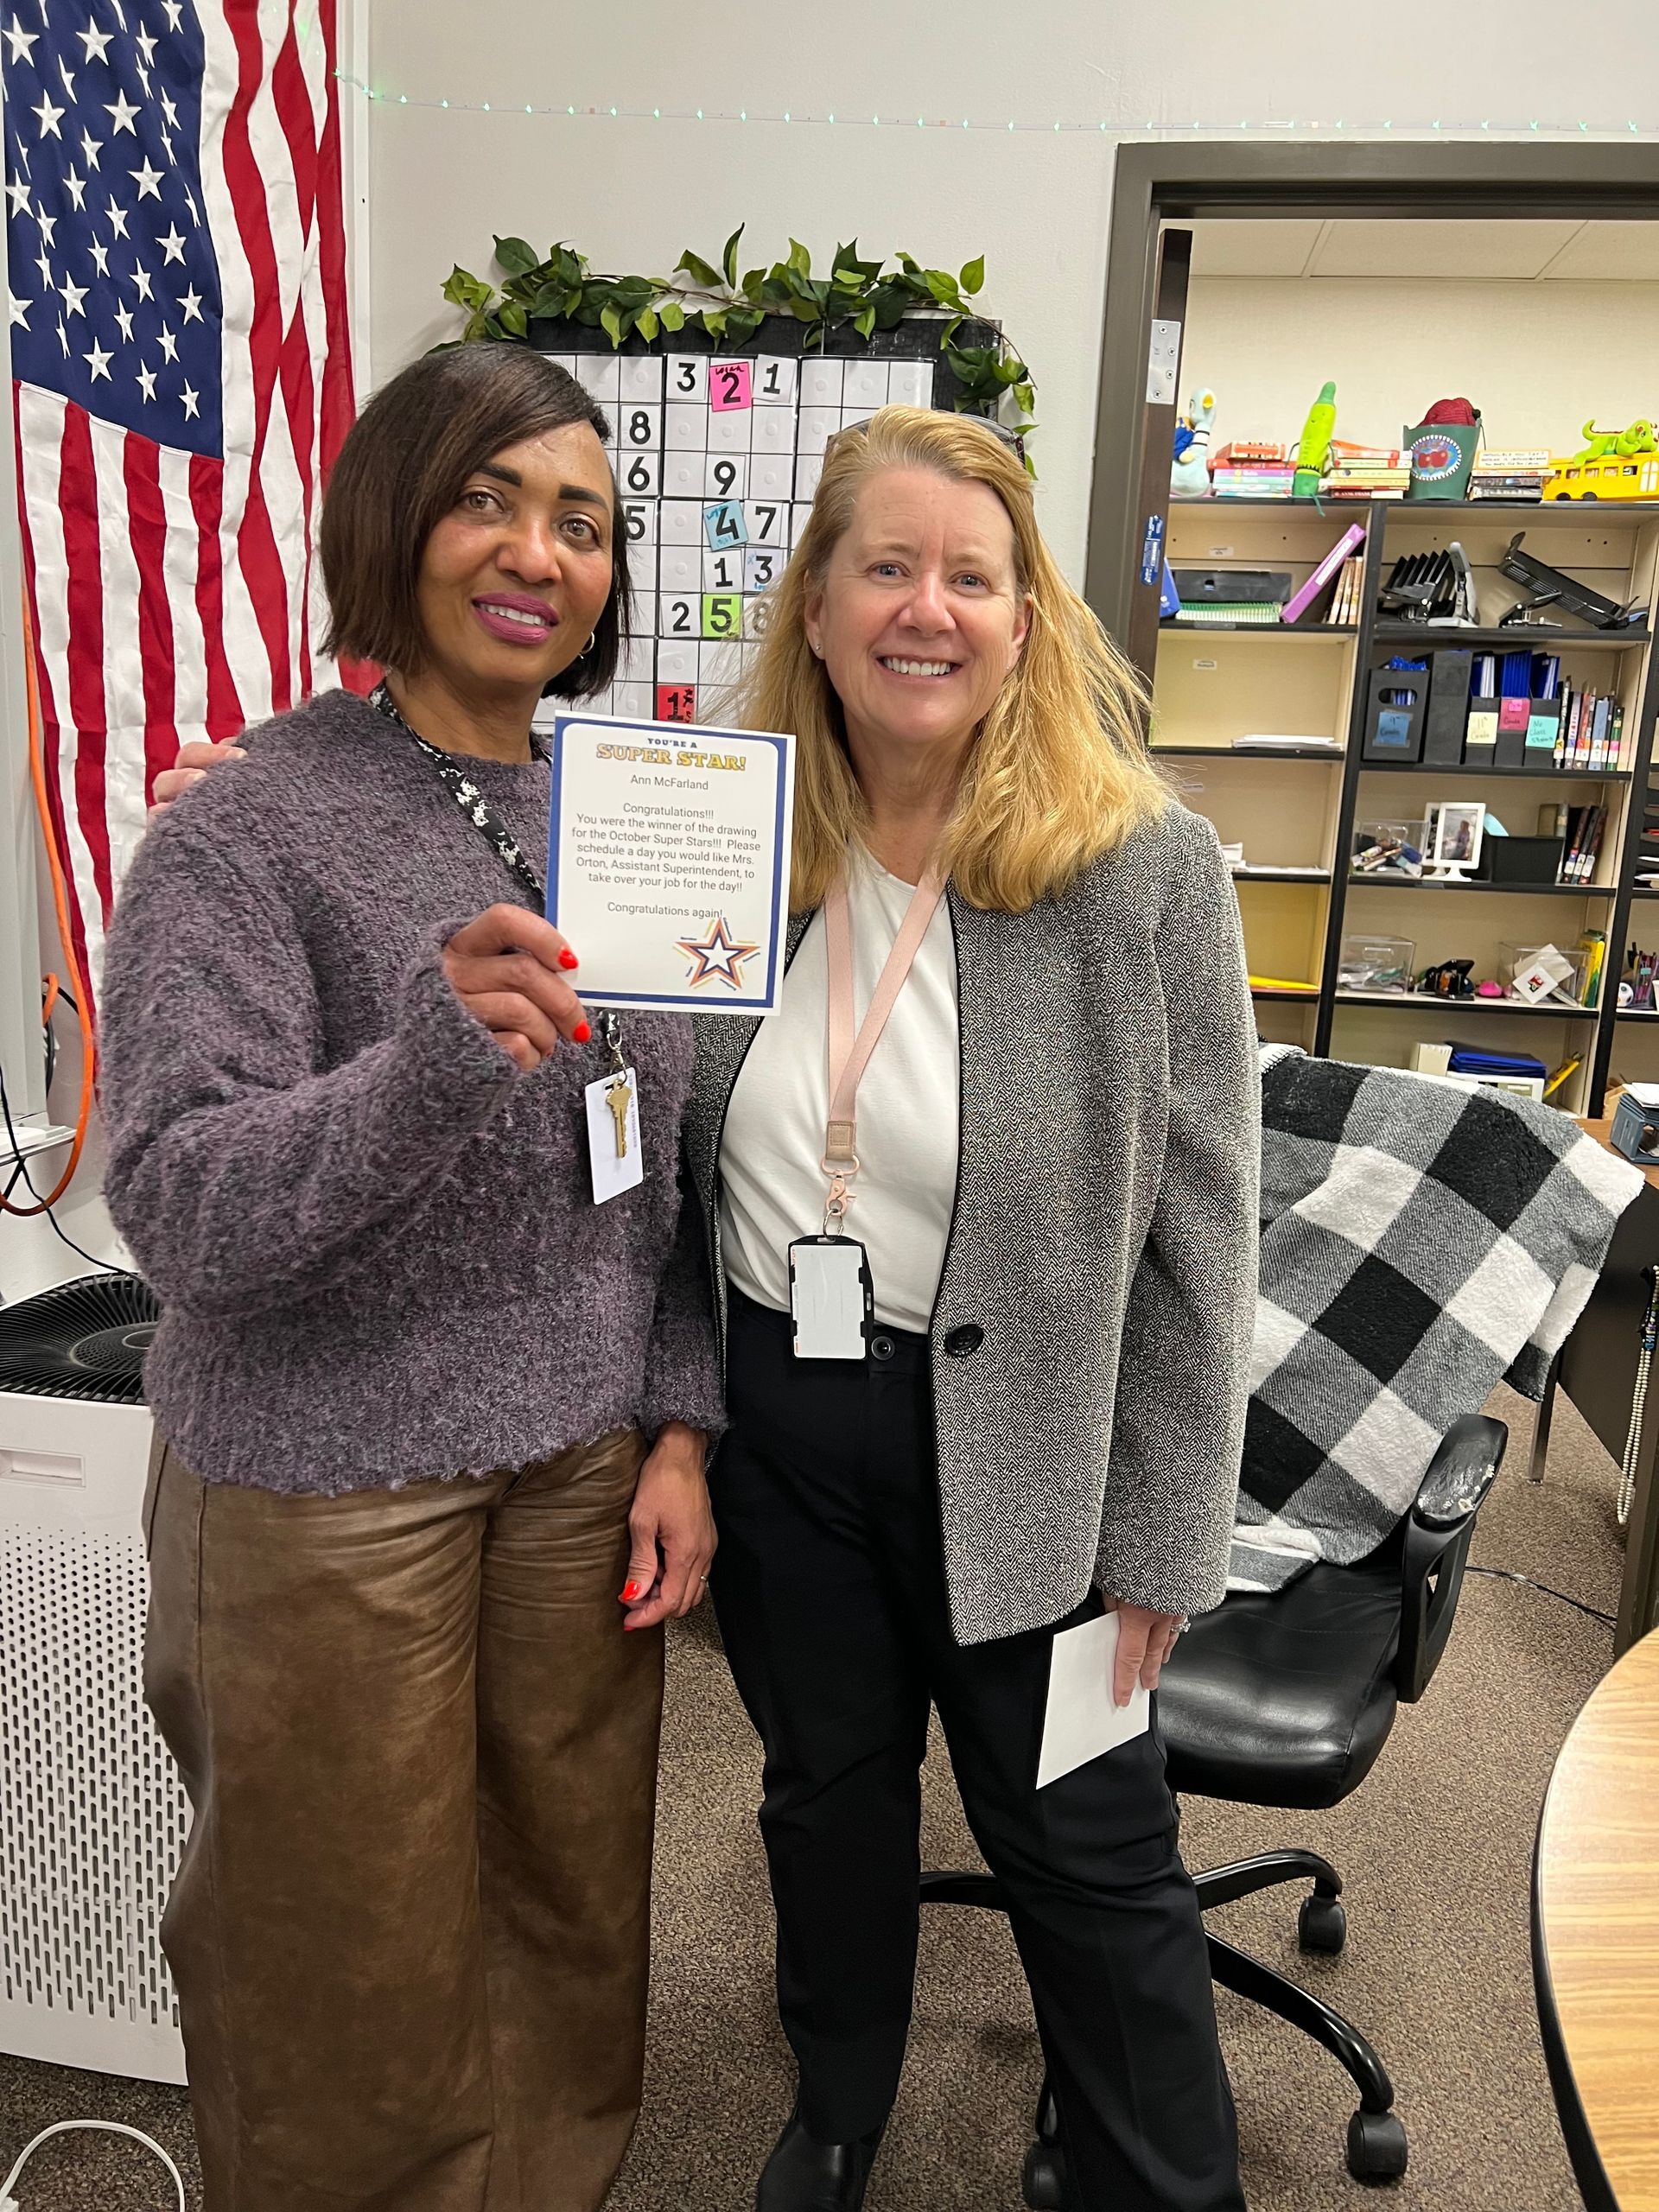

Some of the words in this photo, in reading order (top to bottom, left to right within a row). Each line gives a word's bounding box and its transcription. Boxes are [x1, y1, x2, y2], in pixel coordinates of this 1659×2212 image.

[677, 362, 696, 392] 3
[721, 372, 742, 404] 2
[762, 363, 781, 395] 1
[628, 410, 652, 445] 8
[627, 456, 651, 493] 6
[713, 460, 737, 496] 9
[626, 505, 646, 541] 5
[715, 506, 740, 541] 4
[754, 505, 778, 540] 7
[713, 557, 734, 588] 1
[753, 555, 773, 585] 3
[671, 601, 691, 632] 2
[709, 597, 733, 633] 5
[666, 691, 684, 721] 1
[647, 737, 687, 748] YOU'RE
[596, 742, 673, 766] SUPER
[676, 750, 747, 772] STAR!
[630, 774, 652, 785] Ann
[654, 776, 709, 791] McFarland
[623, 802, 715, 820] Congratulations!!!
[572, 827, 588, 837] for
[590, 829, 607, 840] the
[609, 830, 651, 842] October
[653, 833, 683, 847] Super
[686, 836, 722, 849] Stars!!!
[727, 839, 761, 851] Please
[576, 812, 597, 825] You
[600, 817, 626, 827] were
[628, 817, 645, 829] the
[647, 819, 683, 831] winner
[684, 822, 696, 832] of
[698, 823, 715, 834] the
[716, 824, 757, 839] drawing
[576, 843, 625, 855] schedule
[627, 848, 634, 856] a
[636, 847, 656, 860] day
[658, 850, 677, 861] you
[679, 851, 709, 861] would
[712, 852, 730, 863] like
[733, 854, 754, 865] Mrs.
[576, 856, 609, 870] Orton,
[611, 859, 660, 873] Assistant
[663, 862, 742, 879] Superintendent,
[745, 869, 755, 879] to
[588, 872, 612, 883] take
[613, 875, 637, 885] over
[639, 877, 662, 887] your
[663, 877, 681, 889] job
[683, 878, 698, 889] for
[701, 880, 716, 890] the
[719, 880, 743, 893] day!!
[607, 901, 690, 916] Congratulations
[692, 908, 723, 919] again!
